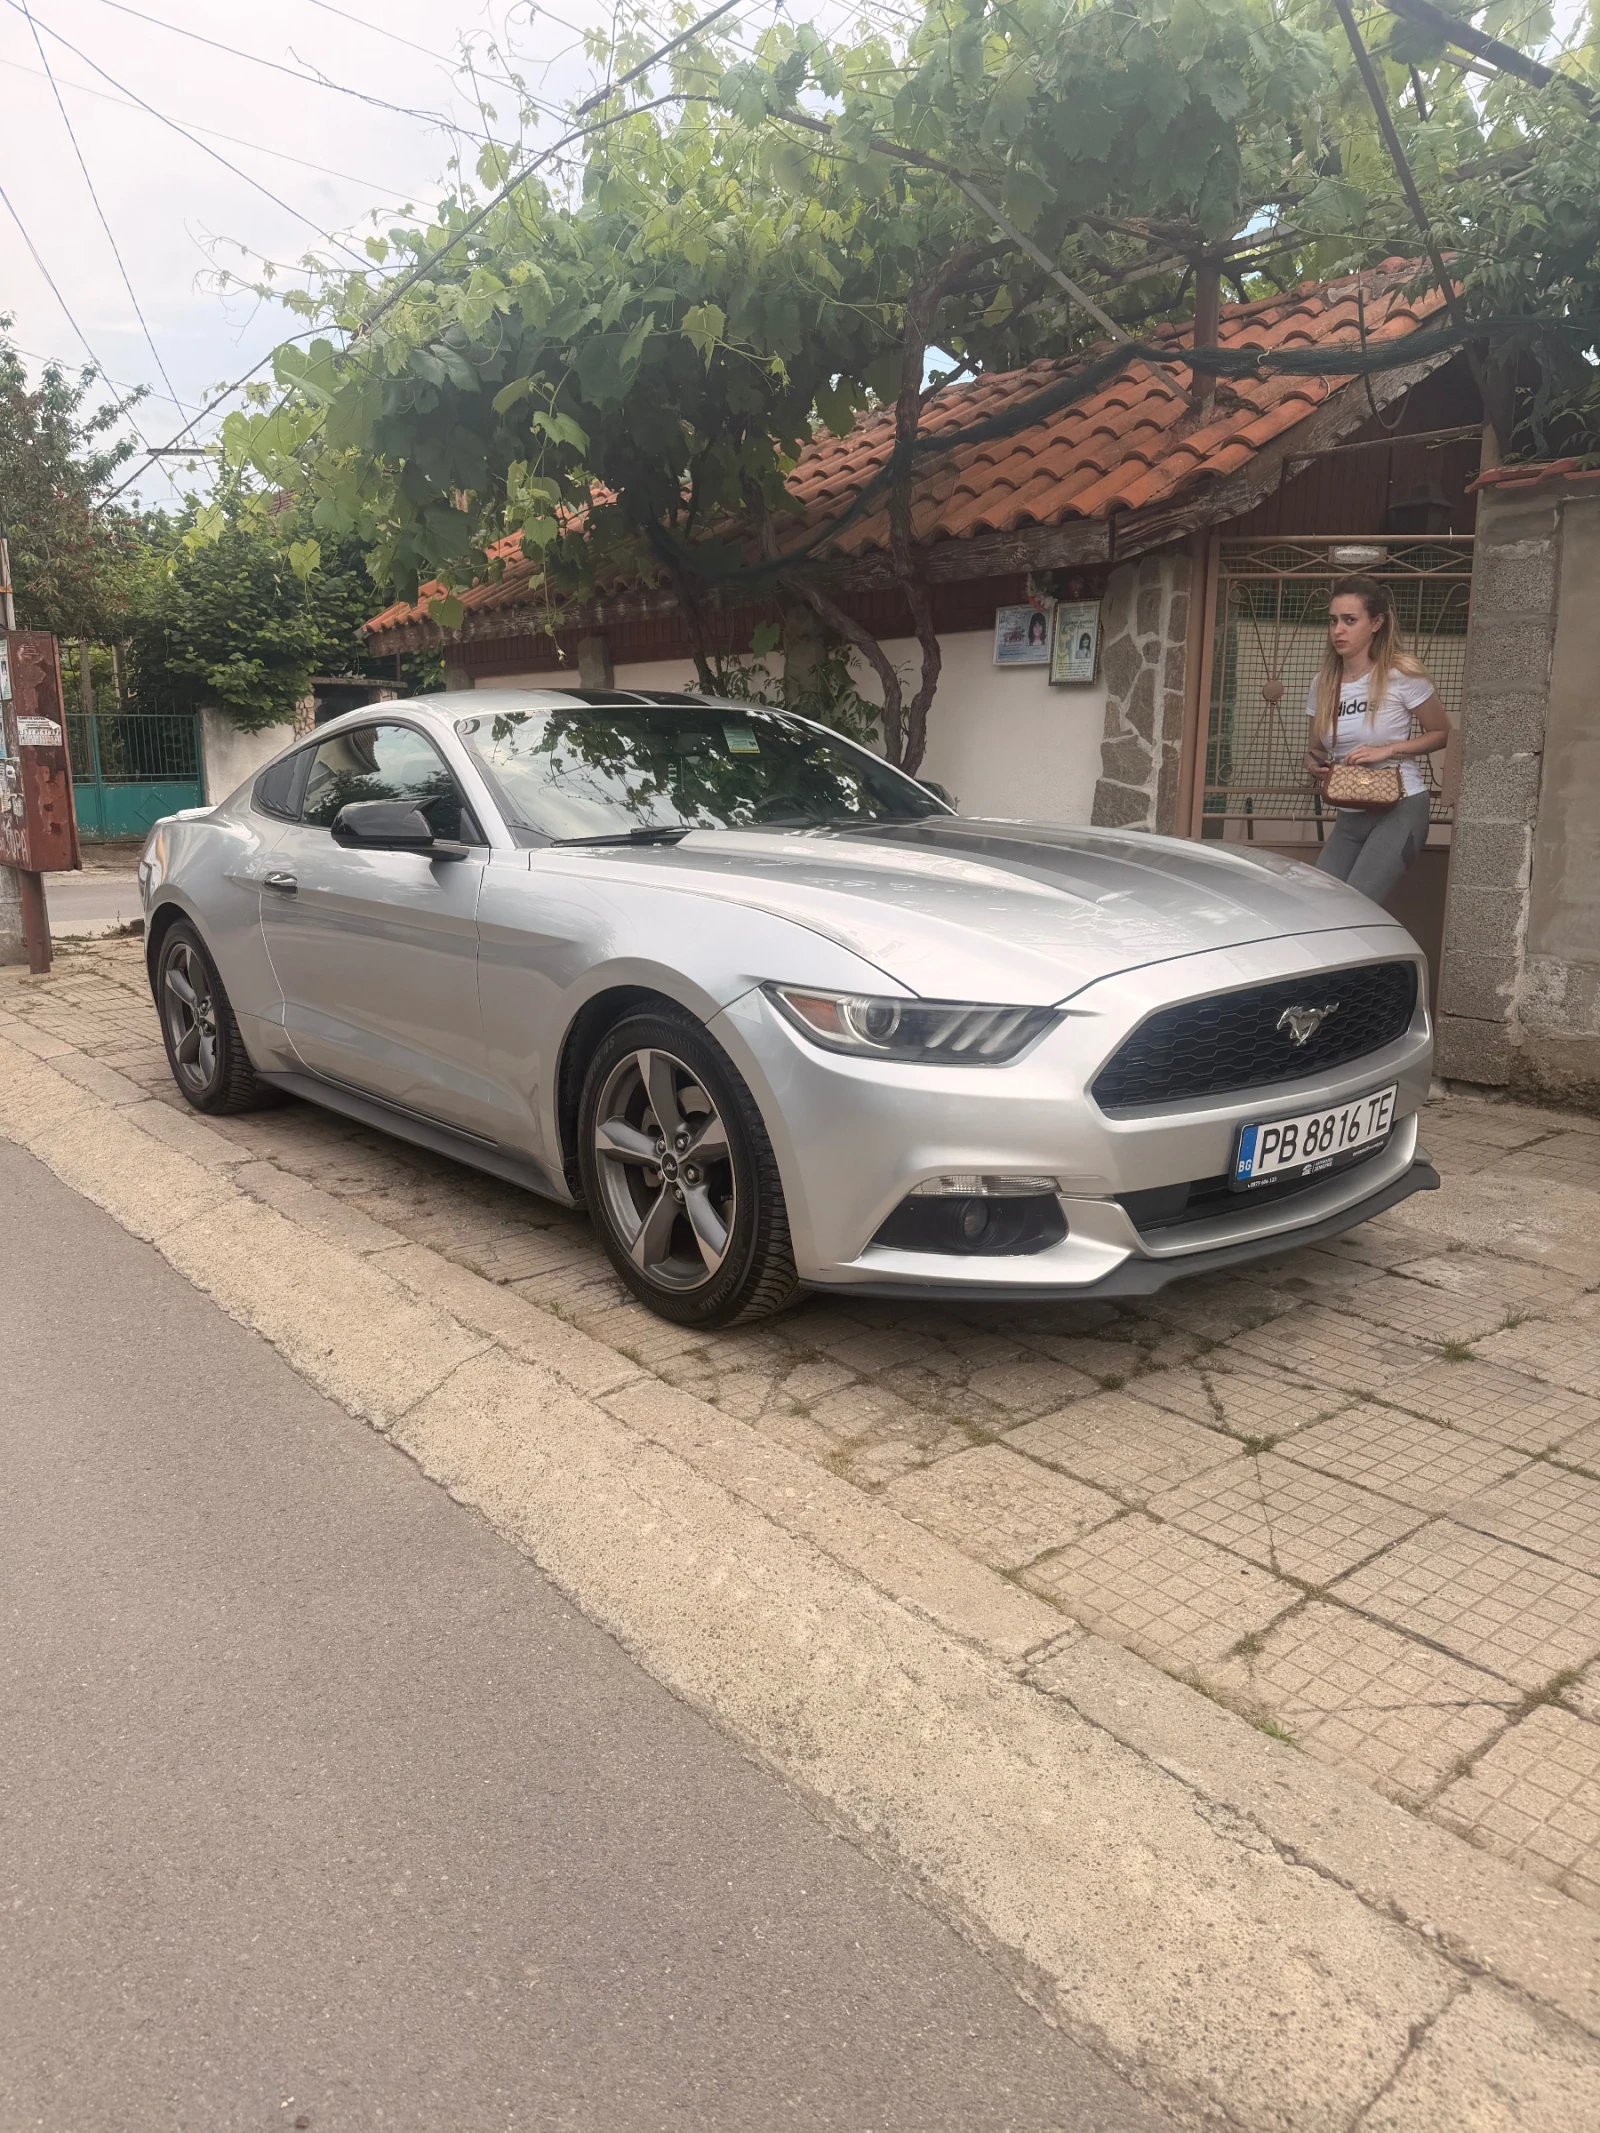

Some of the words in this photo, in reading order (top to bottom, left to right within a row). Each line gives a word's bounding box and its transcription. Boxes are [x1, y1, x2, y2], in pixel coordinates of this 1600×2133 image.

[1258, 1123, 1299, 1169] PB
[1303, 1104, 1362, 1157] 8816
[1366, 1091, 1392, 1136] TE
[1238, 1159, 1252, 1173] BG
[699, 1257, 742, 1310] YOKOHAMA
